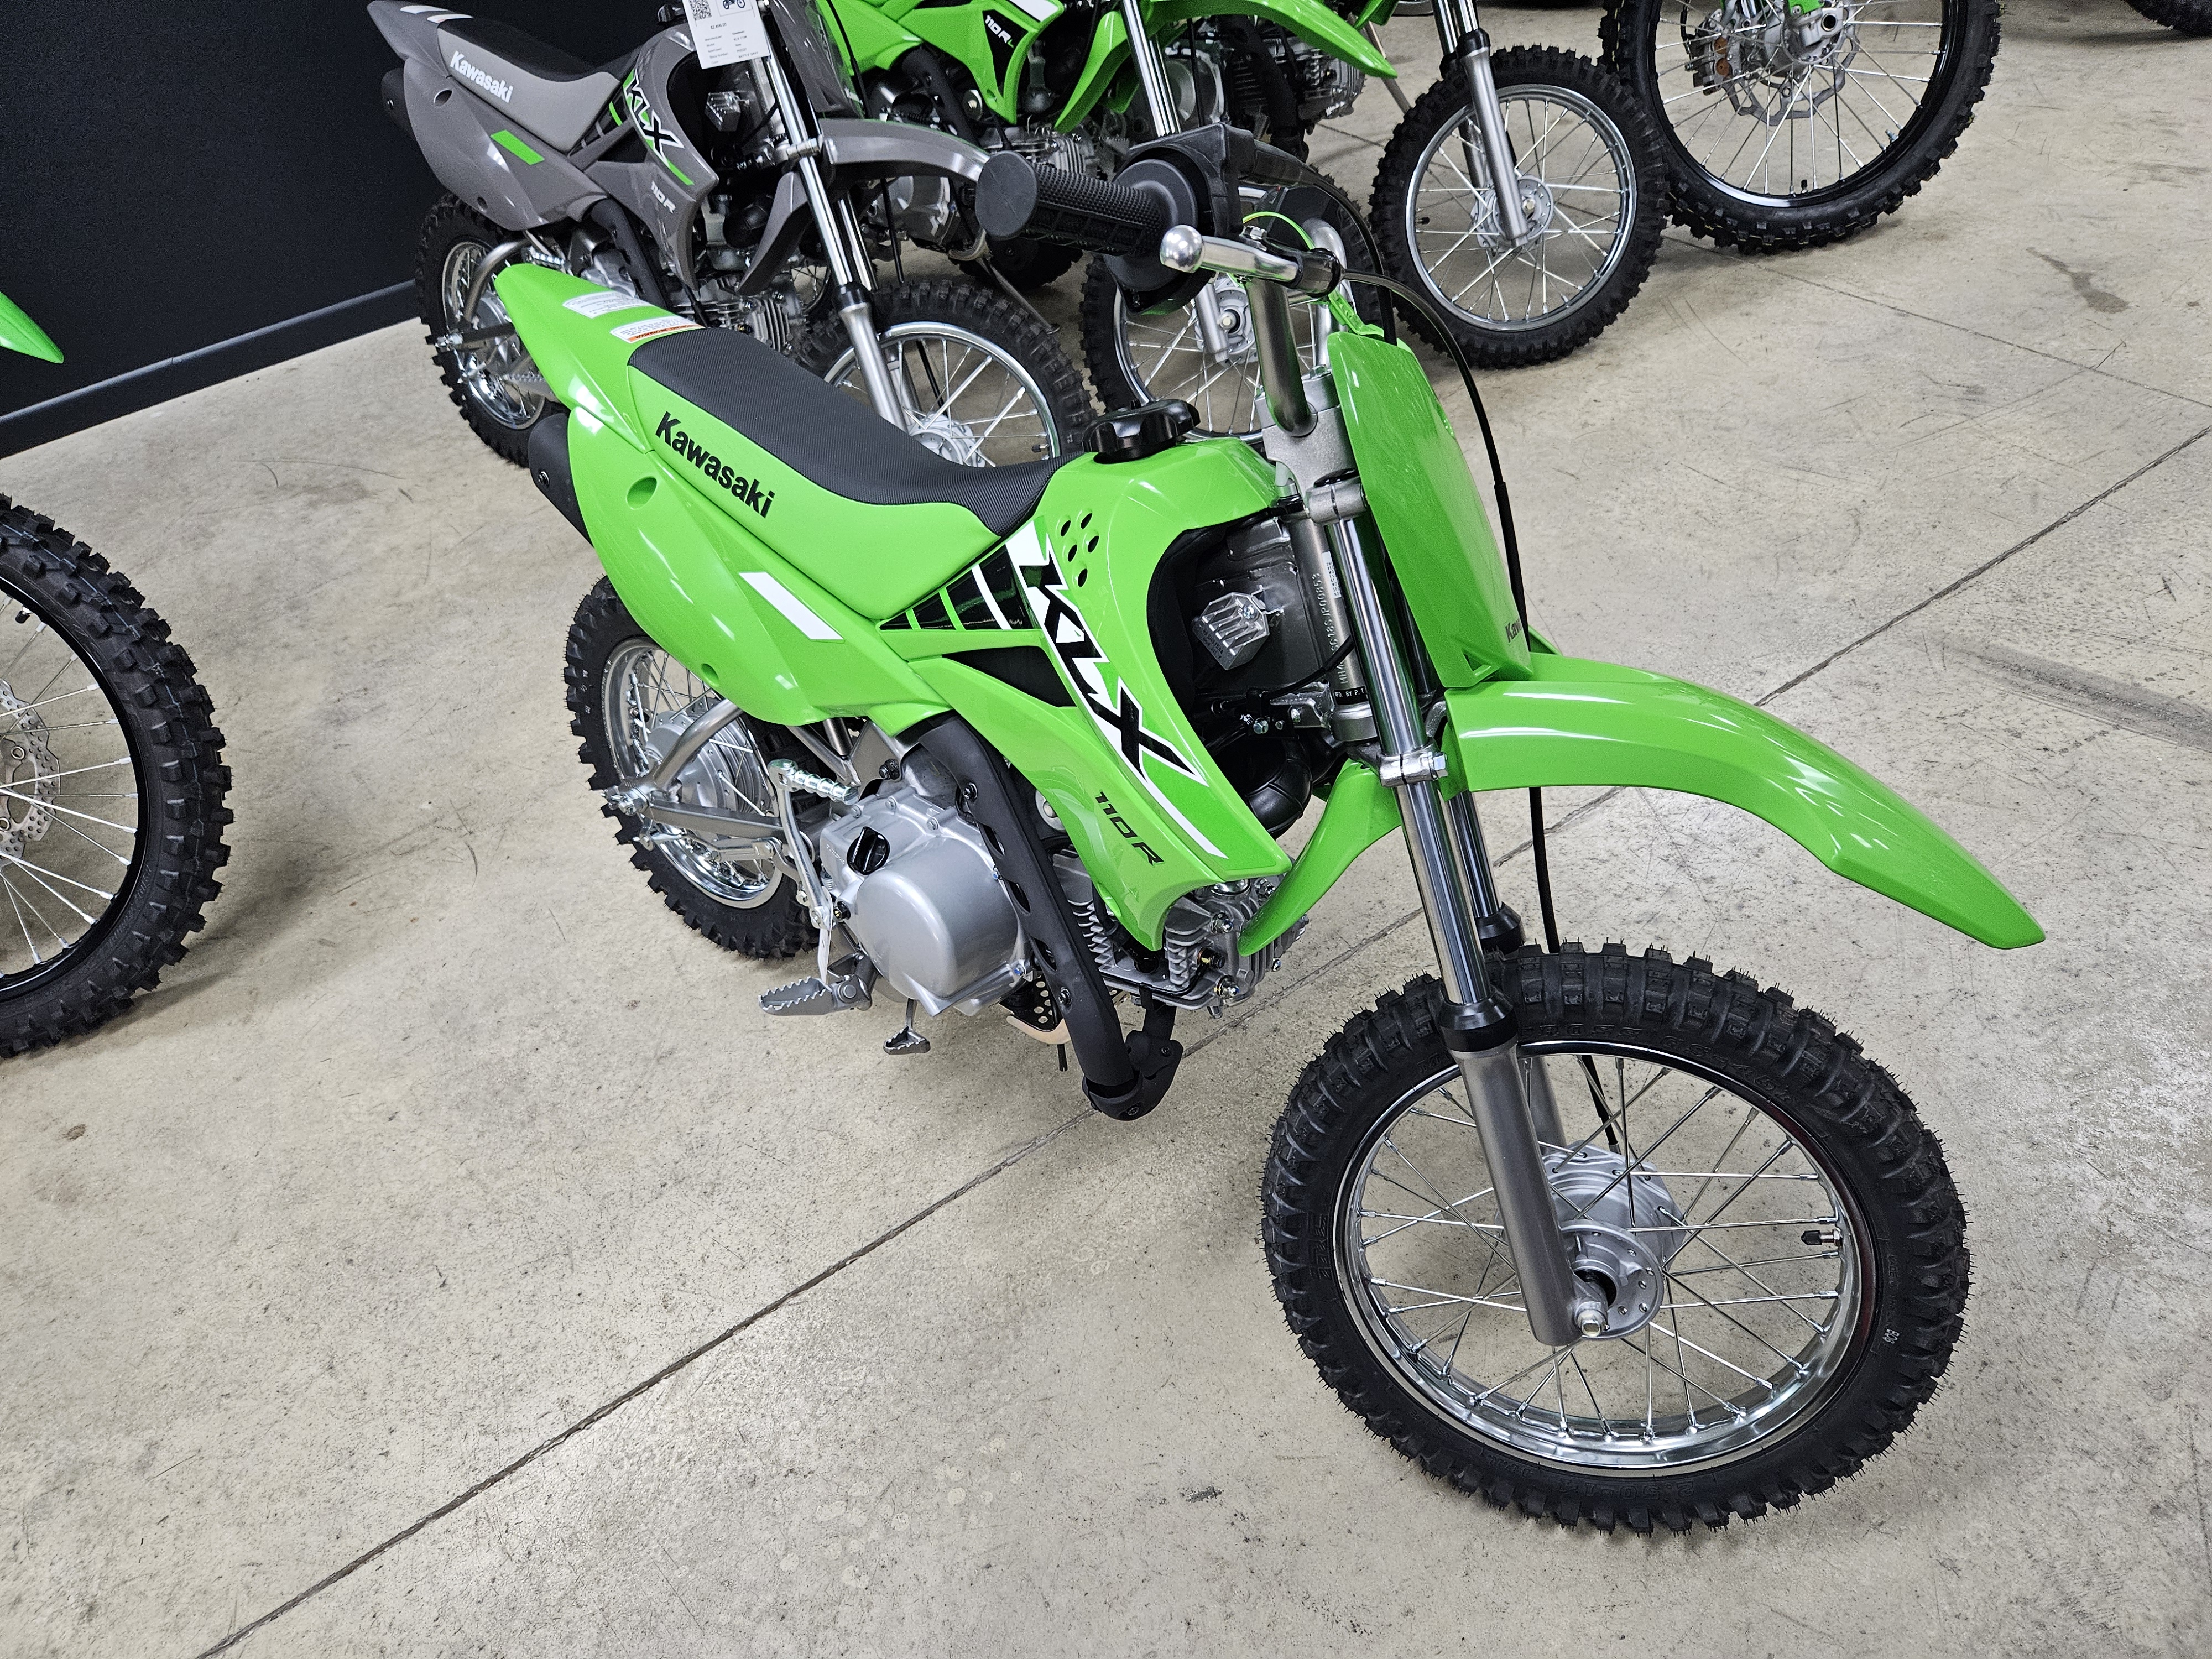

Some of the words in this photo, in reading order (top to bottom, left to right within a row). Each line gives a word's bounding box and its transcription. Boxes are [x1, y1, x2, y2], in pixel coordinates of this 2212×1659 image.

[450, 50, 514, 103] Kawasaki
[624, 71, 685, 165] KLX
[651, 182, 676, 213] 110R
[655, 412, 775, 518] Kawasaki
[1019, 547, 1207, 784] KLX
[1094, 791, 1164, 867] 110R
